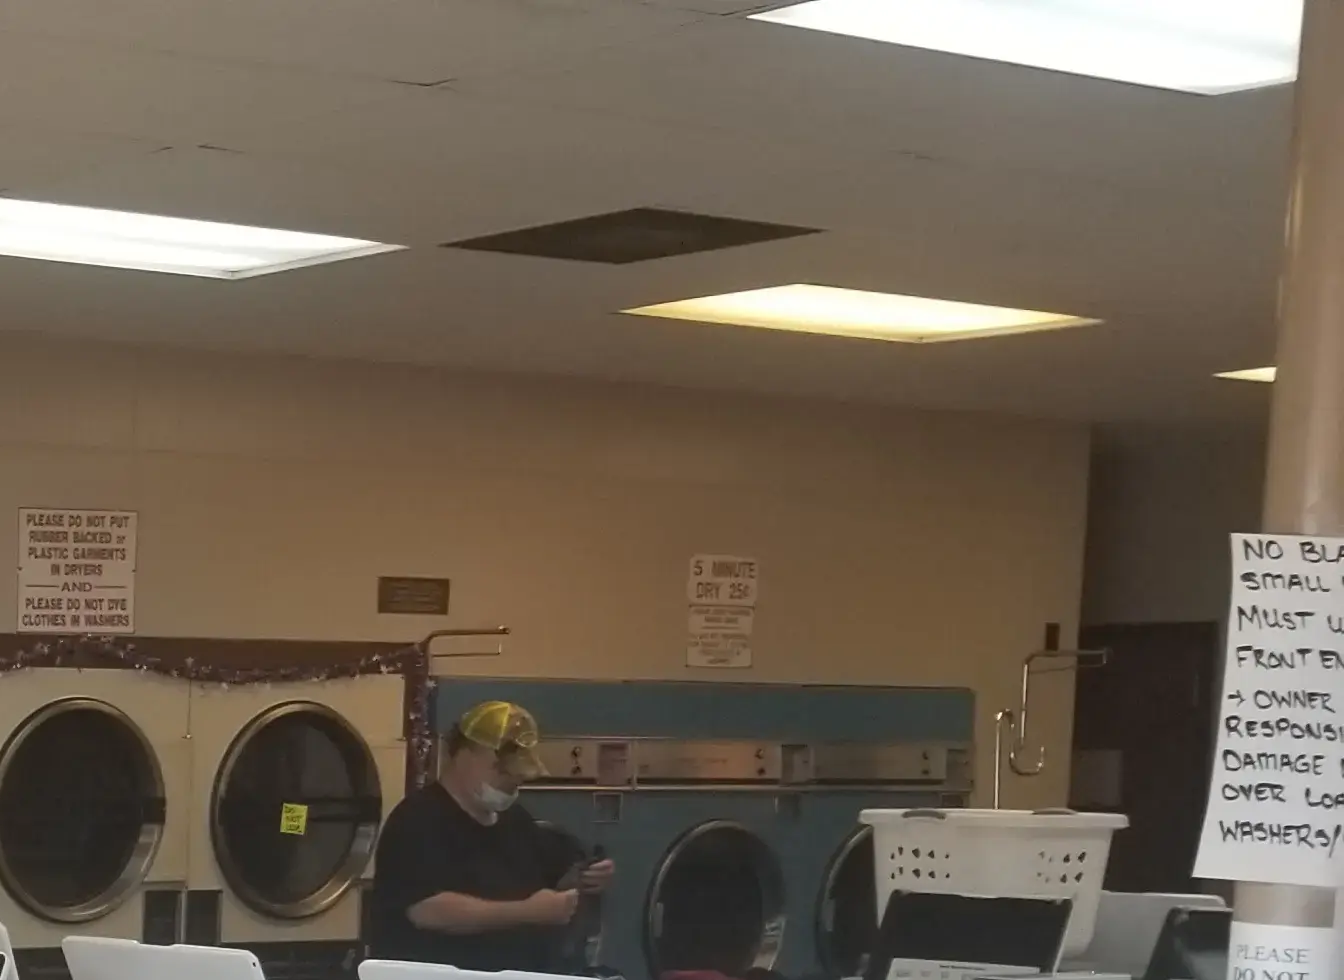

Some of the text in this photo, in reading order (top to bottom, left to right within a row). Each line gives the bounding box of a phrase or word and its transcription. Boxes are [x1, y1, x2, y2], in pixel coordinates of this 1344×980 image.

[26, 514, 130, 528] PLEASE DO NOT PUT
[29, 530, 68, 543] RUBBER
[72, 531, 112, 544] BACKED
[28, 547, 126, 561] PLASTIC GARMENTS
[1242, 539, 1284, 560] NO
[50, 564, 103, 576] IN DRYERS
[694, 560, 704, 576] 5
[61, 582, 92, 592] AND
[1240, 571, 1330, 593] SMALL
[25, 598, 127, 611] PLEASE DO NOT DYE
[22, 614, 129, 627] CLOTHES IN WASHERS
[1236, 645, 1313, 670] FRONT
[1254, 689, 1336, 714] OWNER
[1221, 748, 1325, 776] DAMAGE
[1221, 783, 1287, 803] OVER
[1236, 944, 1311, 964] PLEASE
